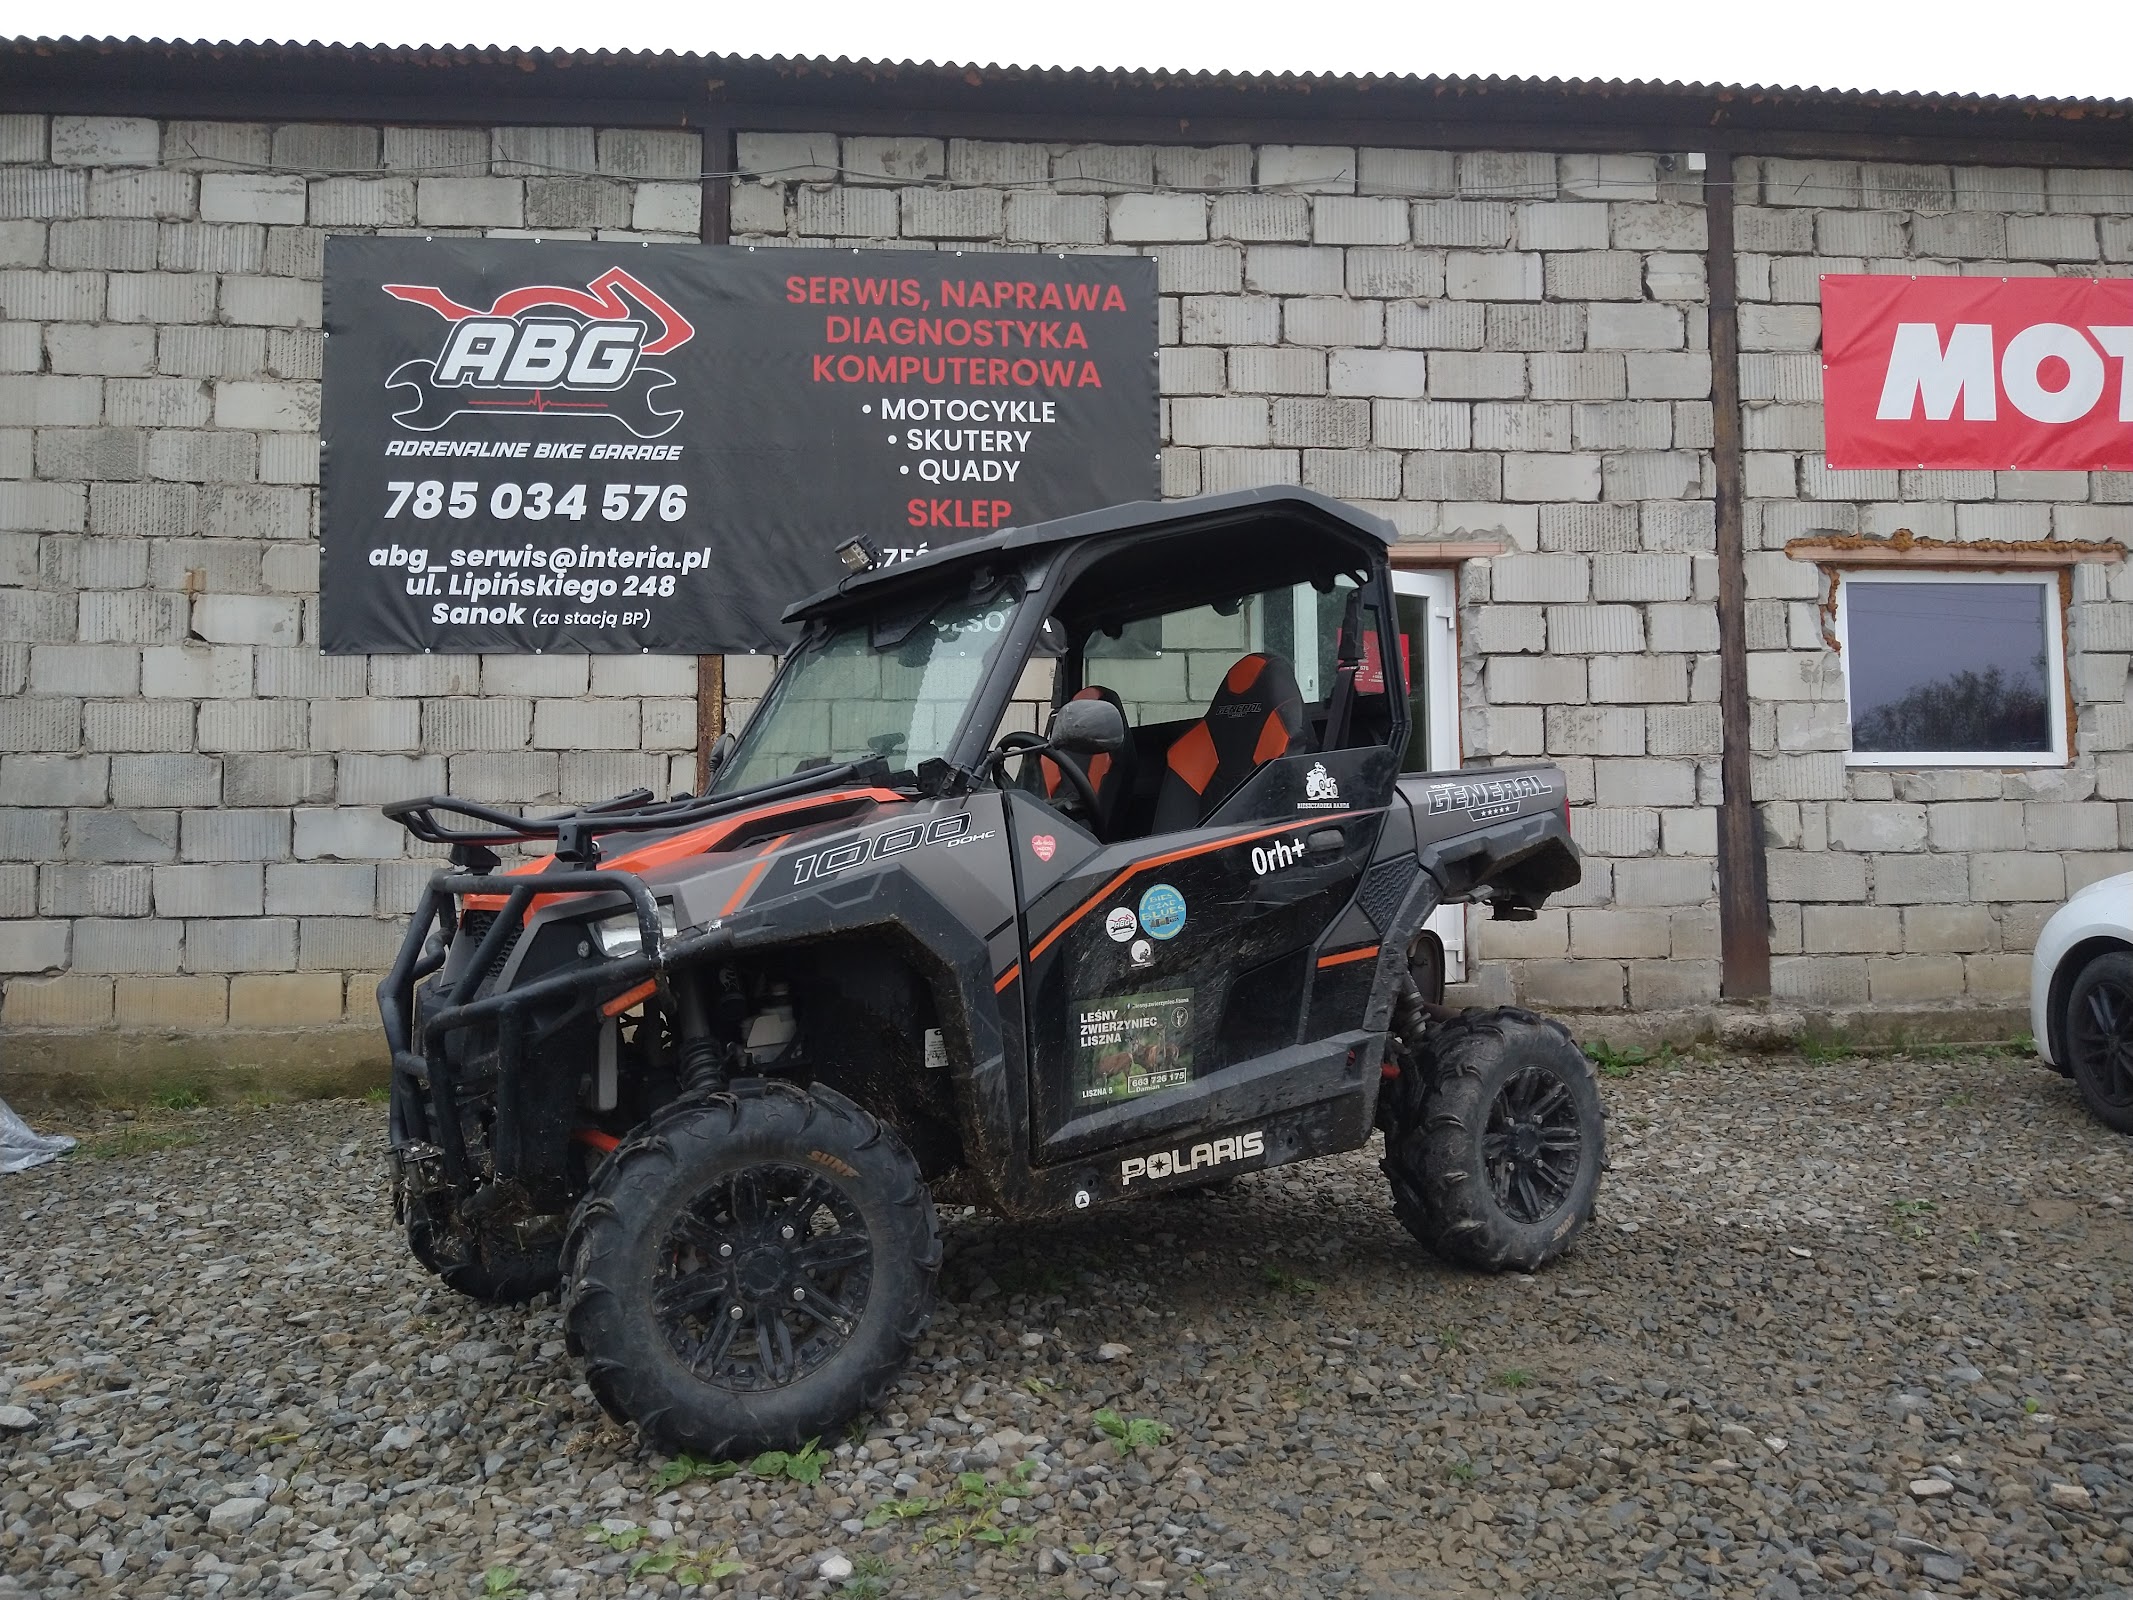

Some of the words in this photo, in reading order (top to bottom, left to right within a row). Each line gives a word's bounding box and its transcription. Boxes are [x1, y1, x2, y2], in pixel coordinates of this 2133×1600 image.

[785, 276, 930, 312] SERWIS,
[940, 280, 1128, 312] NAPRAWA
[825, 316, 1089, 350] DIAGNOSTYKA
[437, 321, 643, 387] ABG
[812, 354, 1103, 388] KOMPUTEROWA
[881, 398, 1056, 423] MOTOCYKLE
[385, 440, 531, 457] ADRENALINE
[533, 443, 586, 459] BIKE
[588, 444, 684, 461] GARAGE
[906, 429, 1032, 453] SKUTERY
[917, 459, 1021, 485] QUADY
[383, 480, 479, 519] 785
[489, 482, 588, 521] 034
[601, 484, 689, 522] 576
[907, 498, 1012, 529] SKLEP
[368, 543, 712, 576] abg_serwis@interia.pl
[405, 574, 442, 597] ul.
[449, 571, 618, 604] Lipińskiego
[621, 575, 675, 598] 248
[431, 602, 528, 625] Sanok
[532, 608, 560, 629] (za
[563, 610, 618, 629] stacją
[621, 608, 651, 629] BP)
[1425, 775, 1553, 816] GENERAL
[794, 812, 973, 886] 1000
[946, 829, 996, 849] DOHC
[1080, 1009, 1119, 1024] LEŚNY
[1080, 1017, 1158, 1035] ZWIERZYNIEC
[1080, 1033, 1122, 1048] LISZNA
[1082, 1087, 1107, 1098] LISZNA
[1132, 1078, 1149, 1087] 663
[1151, 1074, 1167, 1084] 726
[1169, 1072, 1185, 1081] 175
[1136, 1084, 1160, 1093] Damian
[1121, 1131, 1265, 1186] POLARIS
